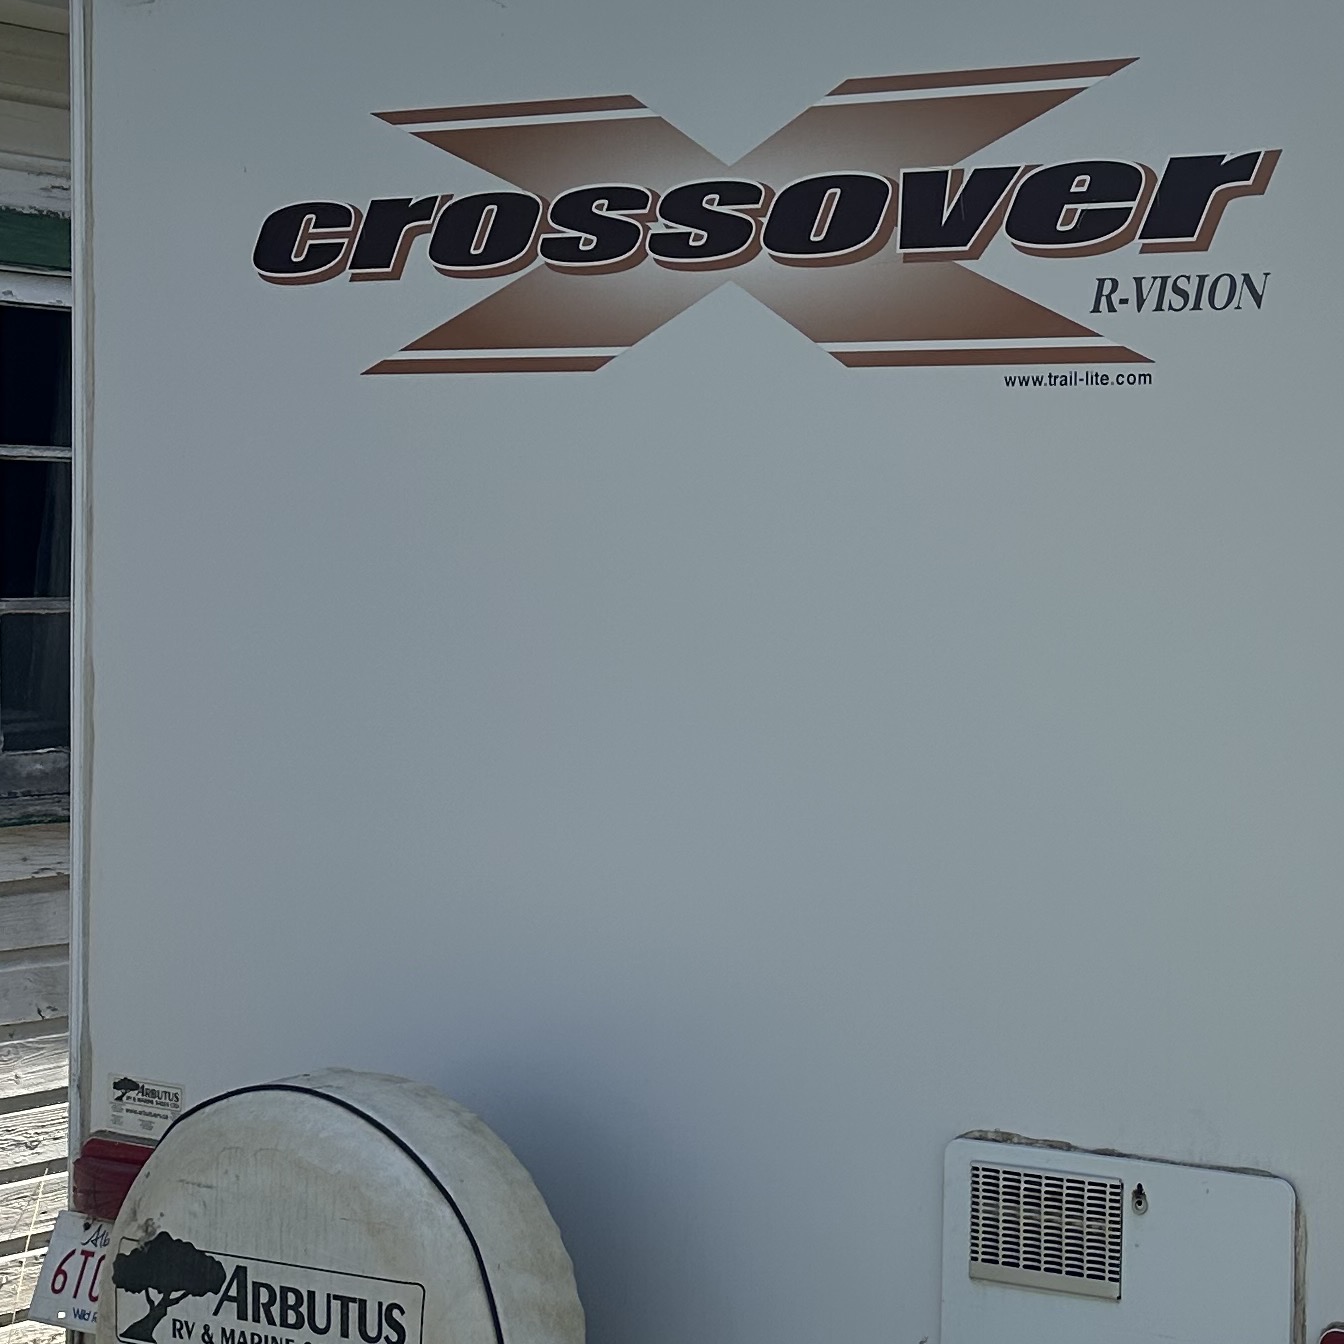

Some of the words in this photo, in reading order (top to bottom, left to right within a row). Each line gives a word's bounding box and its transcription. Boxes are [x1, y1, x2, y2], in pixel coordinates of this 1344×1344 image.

[252, 149, 1282, 283] crossover
[1090, 272, 1271, 313] R-VISION
[1003, 370, 1153, 388] www.trail-lite.com
[172, 1317, 196, 1341] RV
[201, 1325, 214, 1344] &
